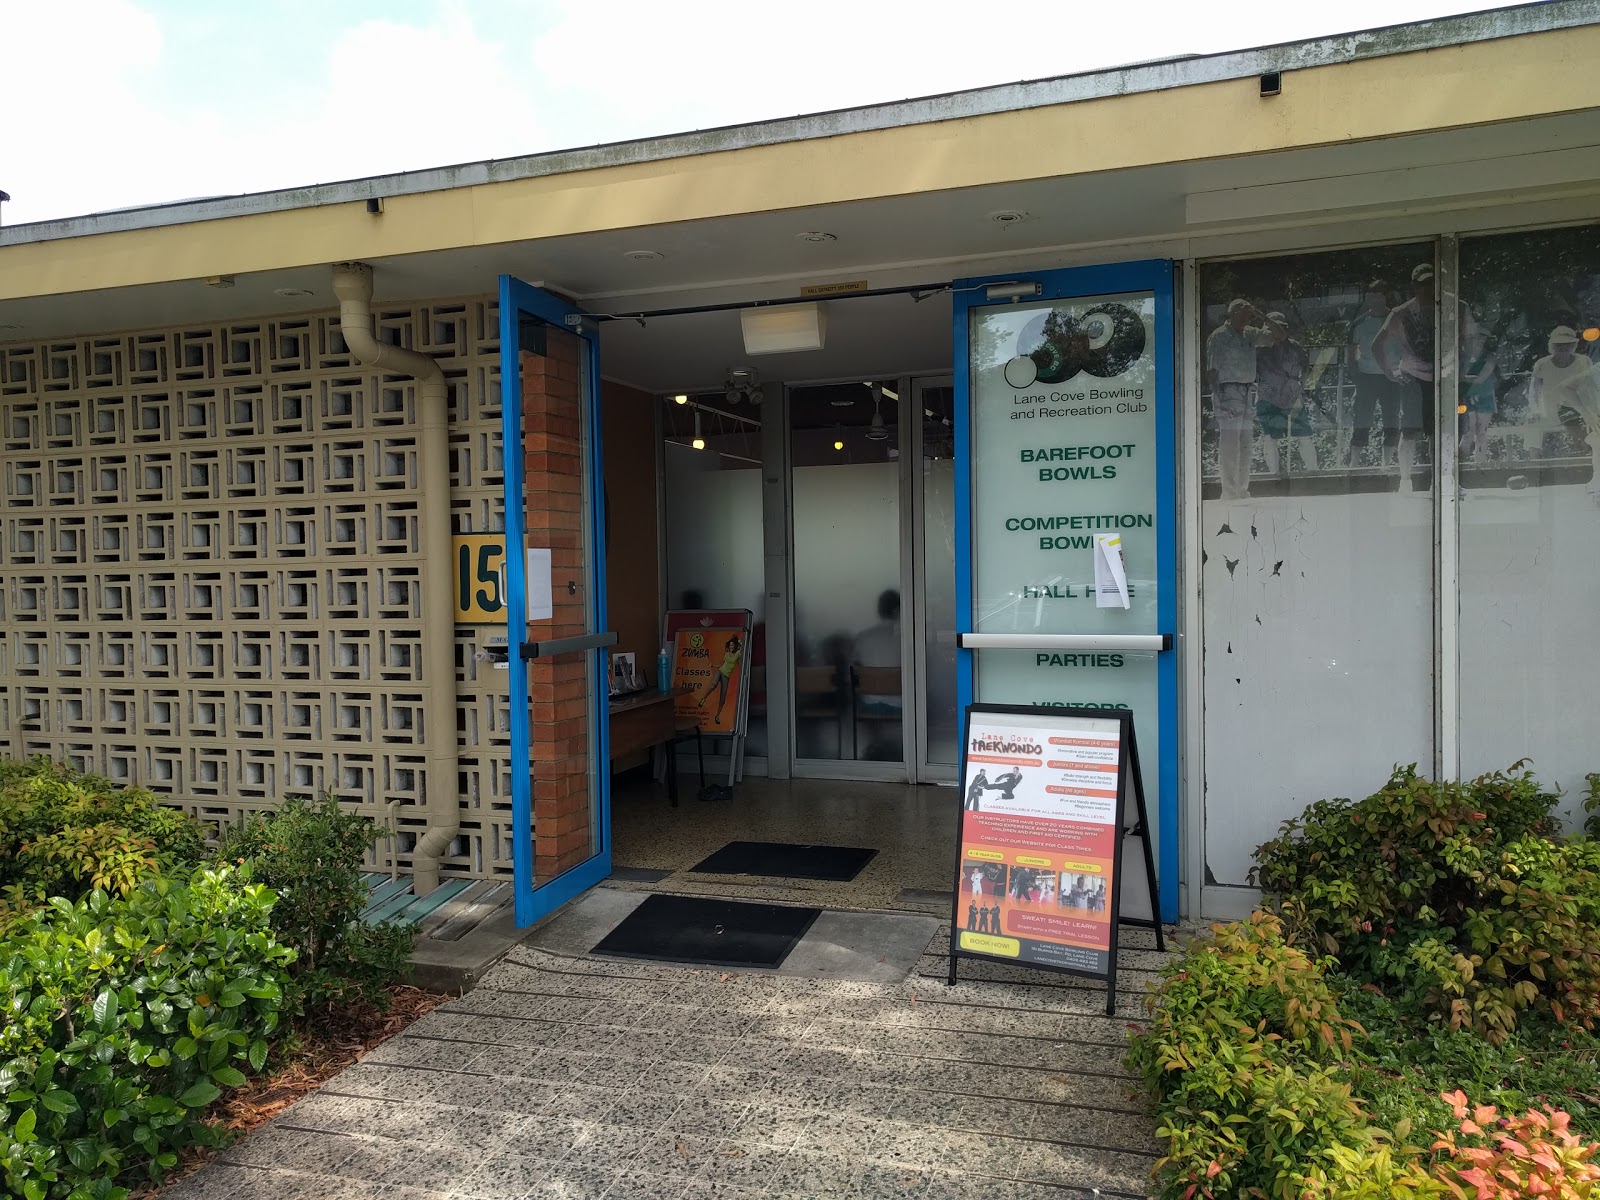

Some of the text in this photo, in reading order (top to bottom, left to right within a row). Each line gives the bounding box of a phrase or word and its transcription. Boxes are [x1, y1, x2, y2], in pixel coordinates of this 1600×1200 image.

[1046, 343, 1059, 358] COVE
[1014, 388, 1144, 404] Lane Cove Bowling
[1010, 402, 1148, 420] and Recreation Club
[1020, 444, 1136, 462] BAREFOOT
[1039, 465, 1116, 481] BOWLS
[1005, 514, 1152, 531] COMPETITION
[1040, 536, 1094, 550] BOW
[1024, 585, 1078, 598] HALL
[1086, 585, 1135, 598] HE
[682, 648, 709, 658] ZUMBA
[1036, 654, 1124, 667] PARTIES
[676, 667, 711, 676] Classes
[682, 681, 703, 689] here
